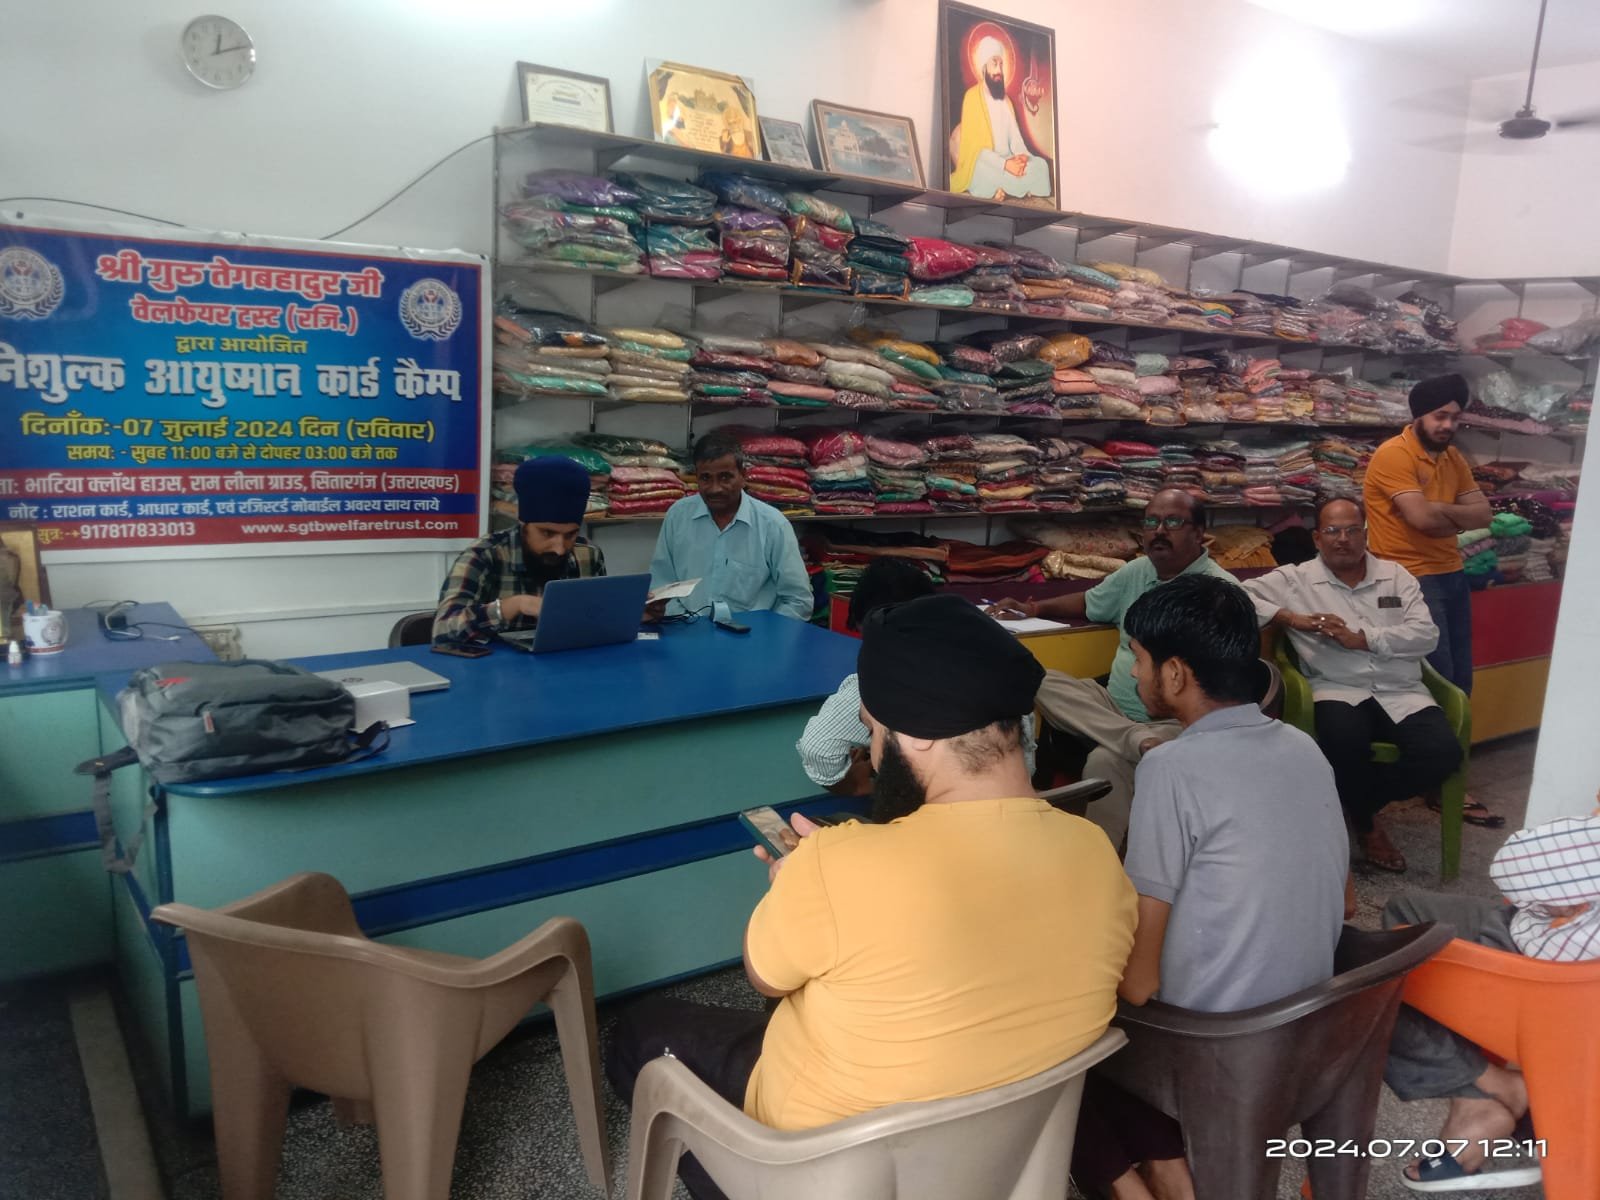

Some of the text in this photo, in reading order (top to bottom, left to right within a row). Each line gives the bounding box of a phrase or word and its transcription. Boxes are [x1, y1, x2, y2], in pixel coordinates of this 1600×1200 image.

[95, 249, 384, 300] श्री गुरु तेगबहादुर जी
[130, 293, 235, 326] वेलफेयर
[285, 302, 358, 336] (रजि.)
[175, 334, 308, 354] द्वारा आयोजित
[145, 359, 302, 408] आयुष्मान
[316, 357, 381, 398] कार्ड
[393, 358, 462, 401] कैम्प
[160, 416, 229, 442] जुलाई
[234, 420, 294, 438] 2024
[299, 416, 340, 438] दिन
[346, 418, 435, 443] (रविवार)
[130, 445, 167, 464] सुबह
[172, 446, 211, 460] 11:00
[215, 443, 238, 460] बजे
[243, 443, 256, 460] से
[260, 443, 301, 460] दोपहर
[305, 446, 347, 460] 03:00
[351, 443, 372, 460] बजे
[375, 447, 398, 460] तक
[24, 472, 84, 494] भाटिया
[86, 472, 136, 492] क्लॉथ
[139, 475, 187, 493] हाउस,
[189, 475, 221, 491] राम
[223, 470, 265, 491] लीला
[310, 470, 378, 490] सितारगंज
[381, 472, 459, 493] (उत्तराखण्ड)
[8, 502, 40, 519] नोट
[51, 504, 96, 518] राशन
[98, 500, 133, 518] कार्ड,
[137, 502, 179, 515] आधार
[182, 499, 213, 516] कार्ड,
[215, 500, 236, 514] एवं
[290, 497, 341, 513] मोबाईल
[344, 499, 382, 511] अवश्य
[383, 499, 411, 511] साथ
[80, 522, 196, 540] 917817833013
[241, 520, 459, 535] www.sgtbwelfaretrust.com
